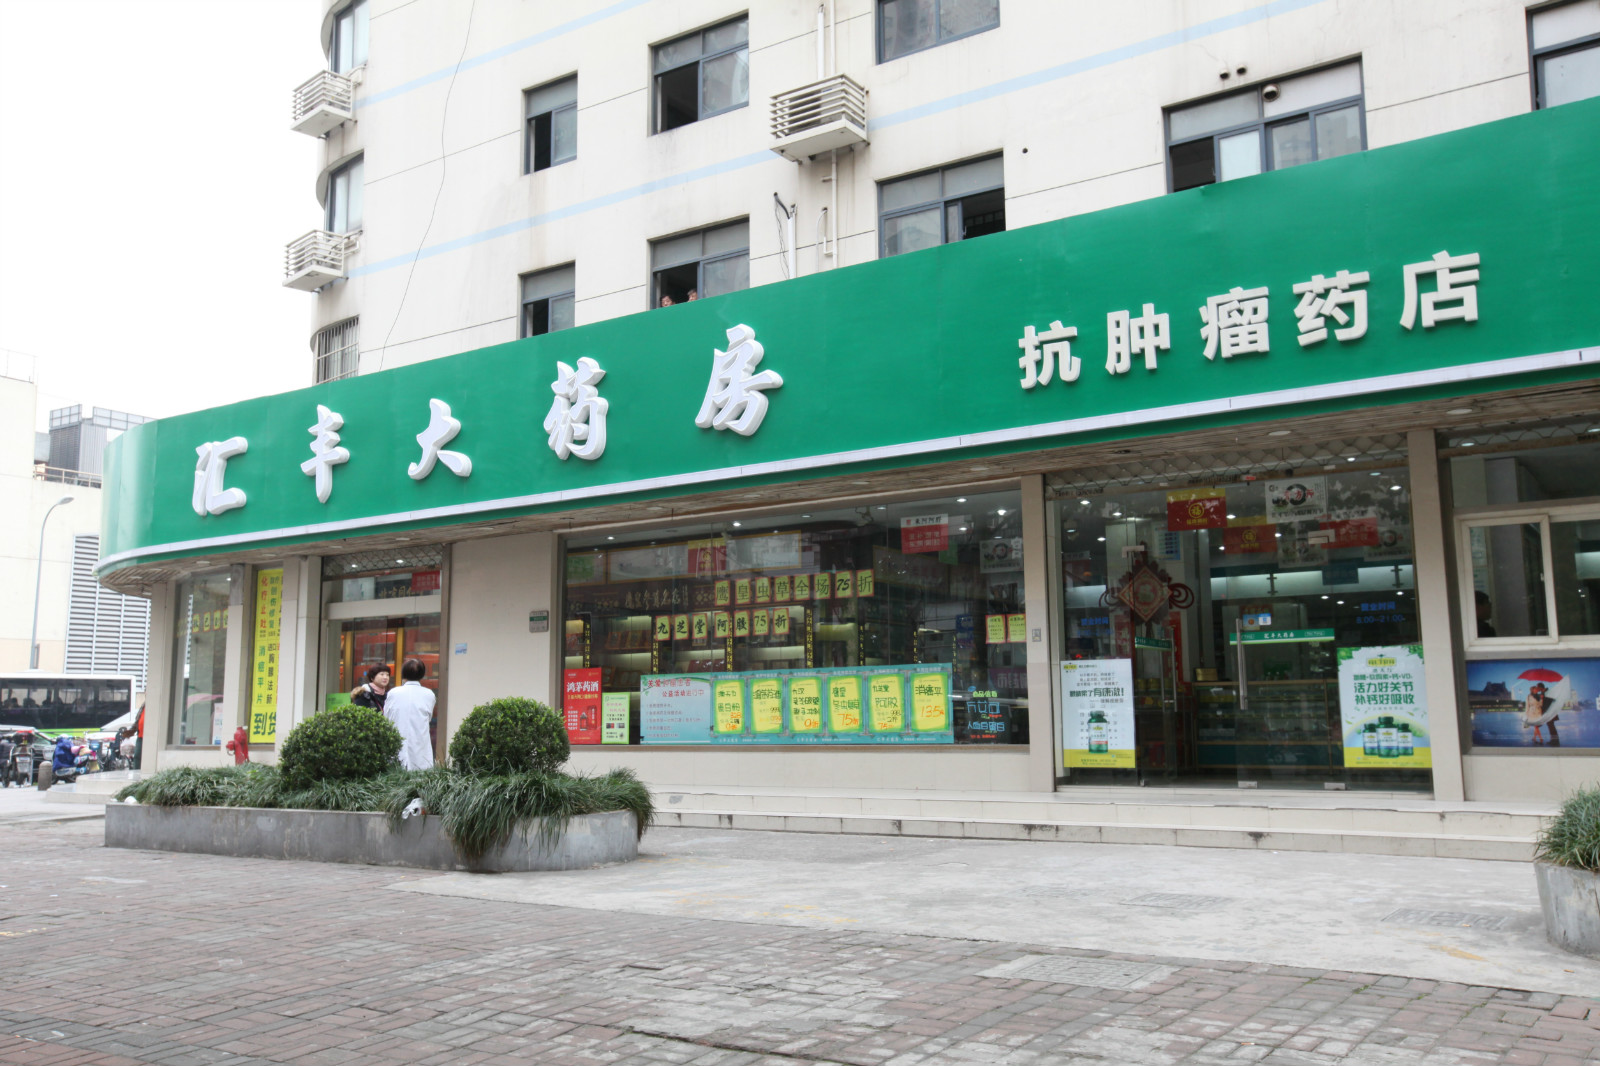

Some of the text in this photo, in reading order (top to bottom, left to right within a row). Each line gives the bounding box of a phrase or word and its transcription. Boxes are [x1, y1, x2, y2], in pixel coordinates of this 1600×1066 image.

[1018, 250, 1481, 389] 抗肿瘤药店
[192, 323, 784, 516] 汇丰大药房
[716, 575, 873, 597] 鹰皇虫草全场75折
[260, 576, 268, 628] 化疗止吐
[657, 614, 788, 636] 九芝堂阿胶75折
[256, 645, 266, 704] 消癌平片
[567, 680, 599, 692] 鸿茅药酒
[1353, 681, 1414, 694] 活力好关节
[1354, 693, 1415, 705] 补钙好吸收
